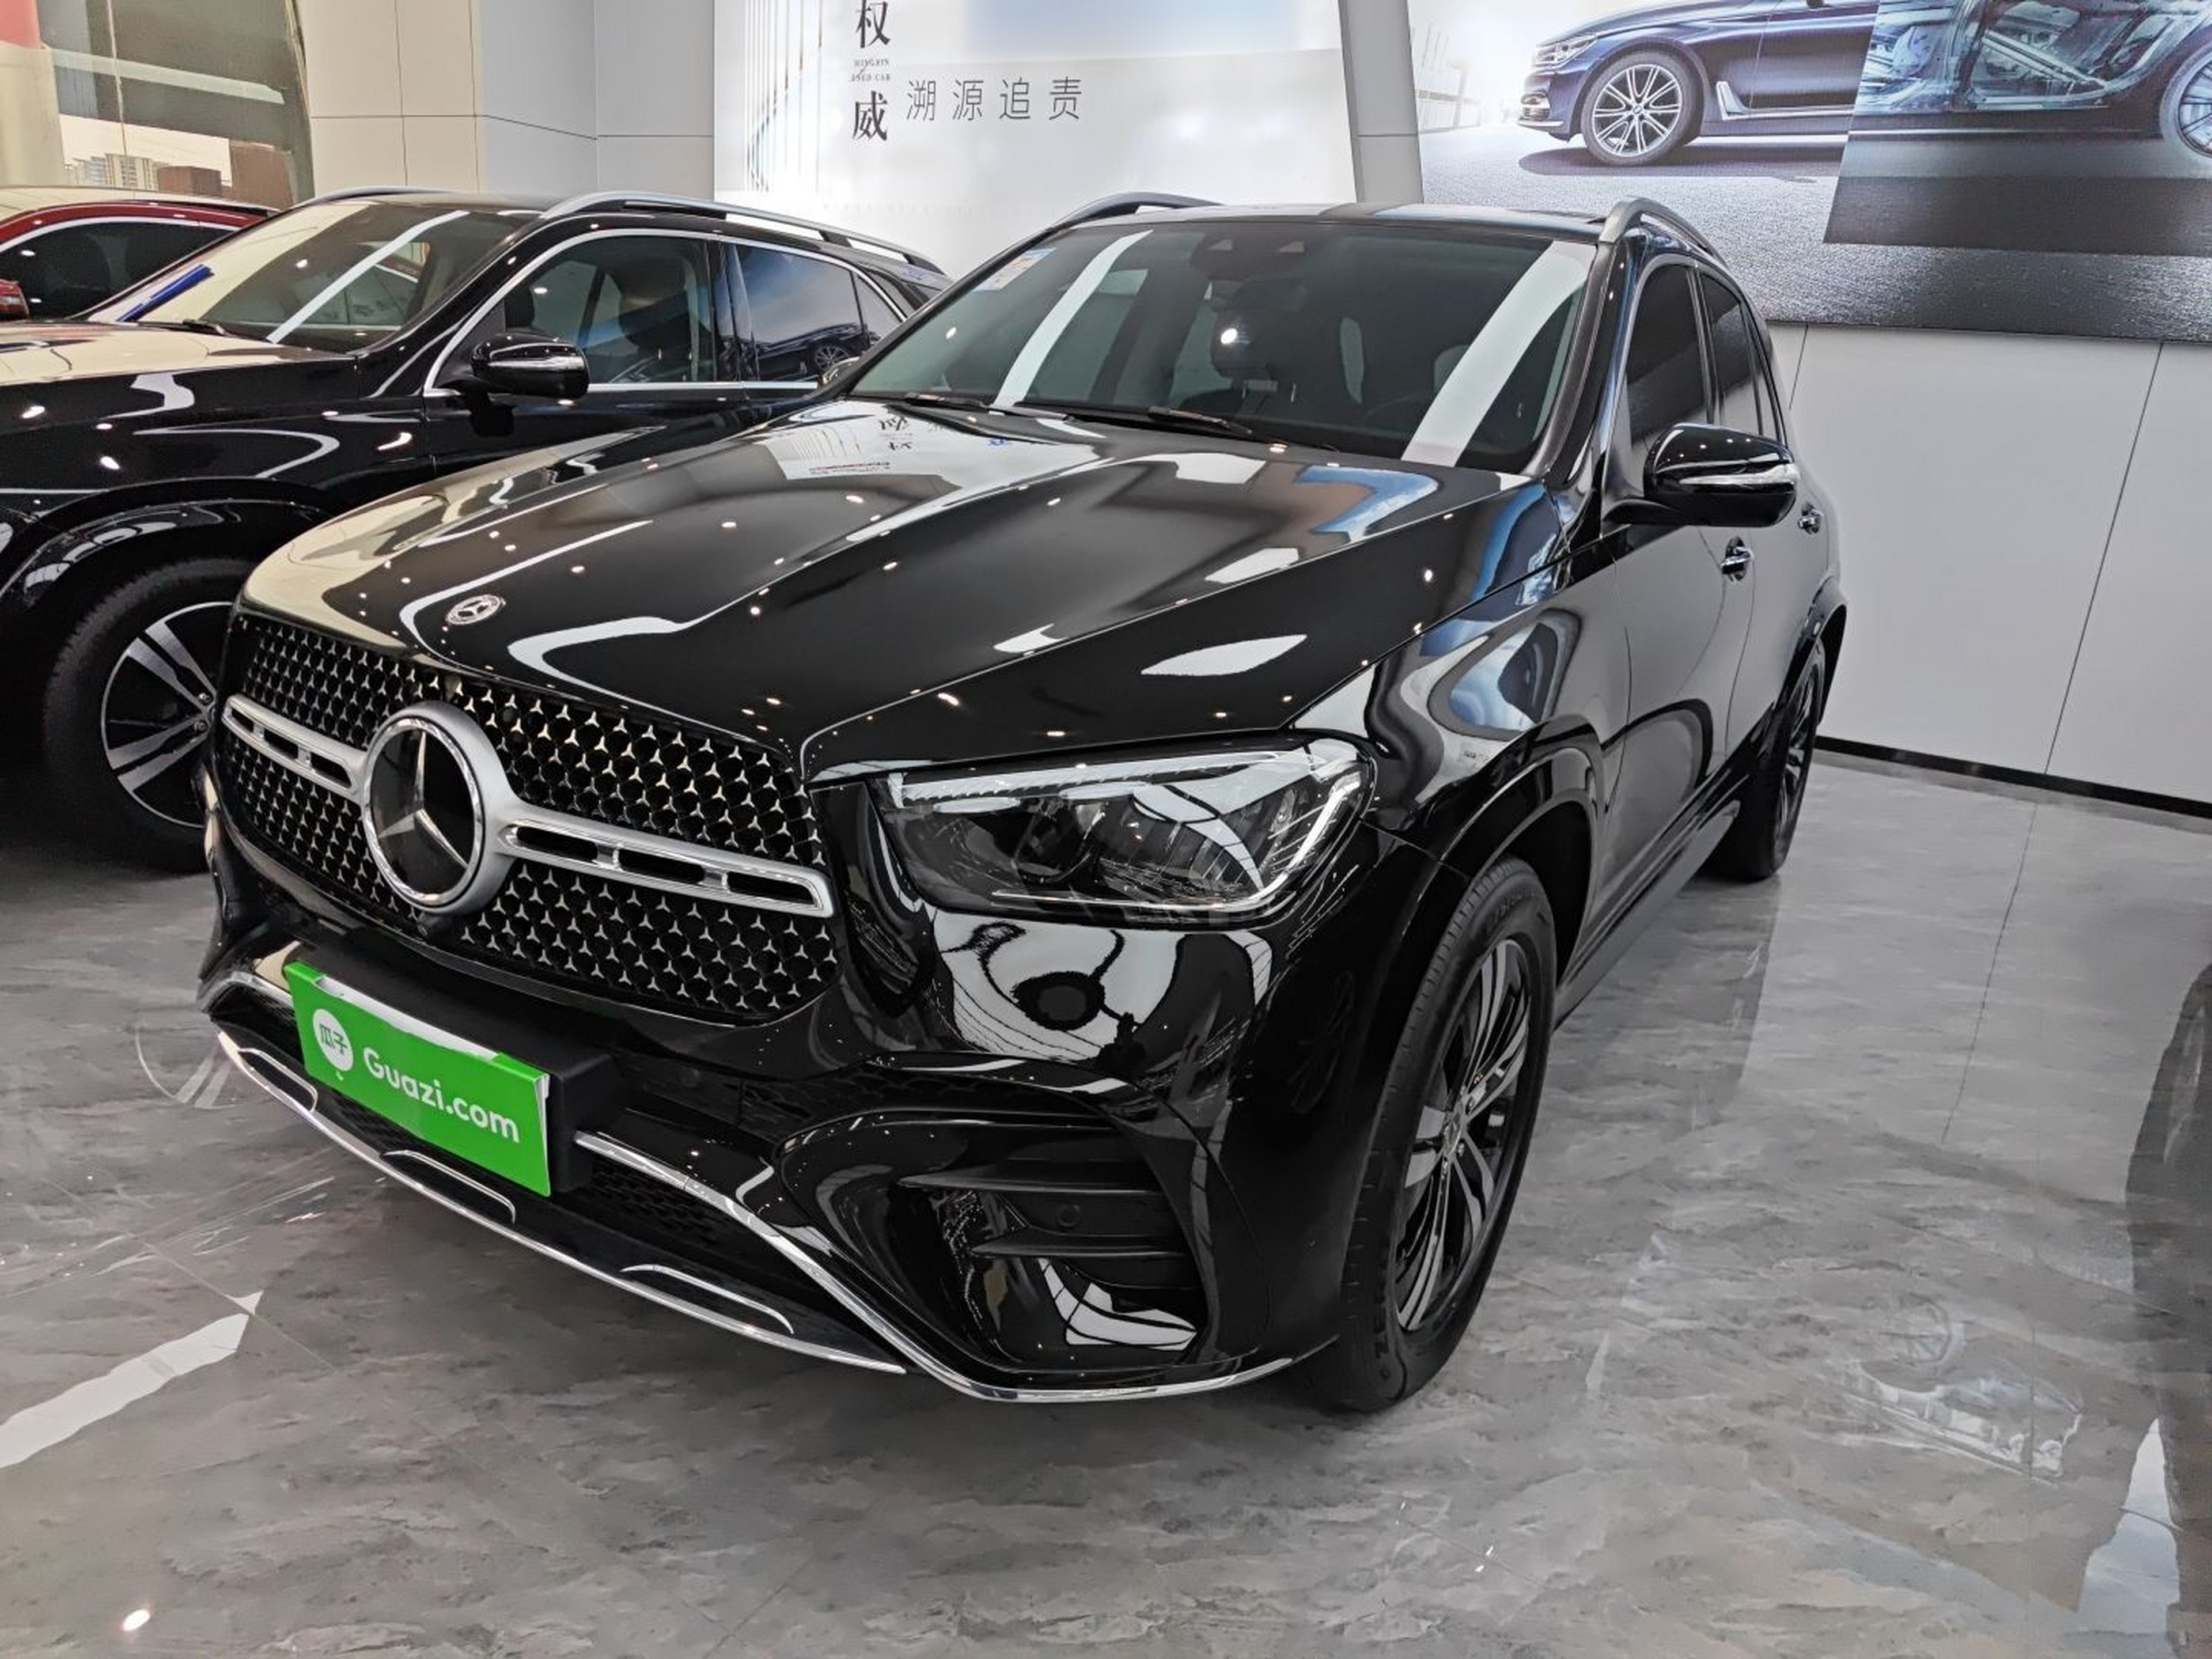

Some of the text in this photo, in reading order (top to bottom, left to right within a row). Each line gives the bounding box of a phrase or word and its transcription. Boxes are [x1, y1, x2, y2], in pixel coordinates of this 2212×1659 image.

[906, 76, 1082, 121] 溯源追责
[319, 1023, 348, 1055] 瓜子
[363, 1047, 520, 1143] Guazi.com
